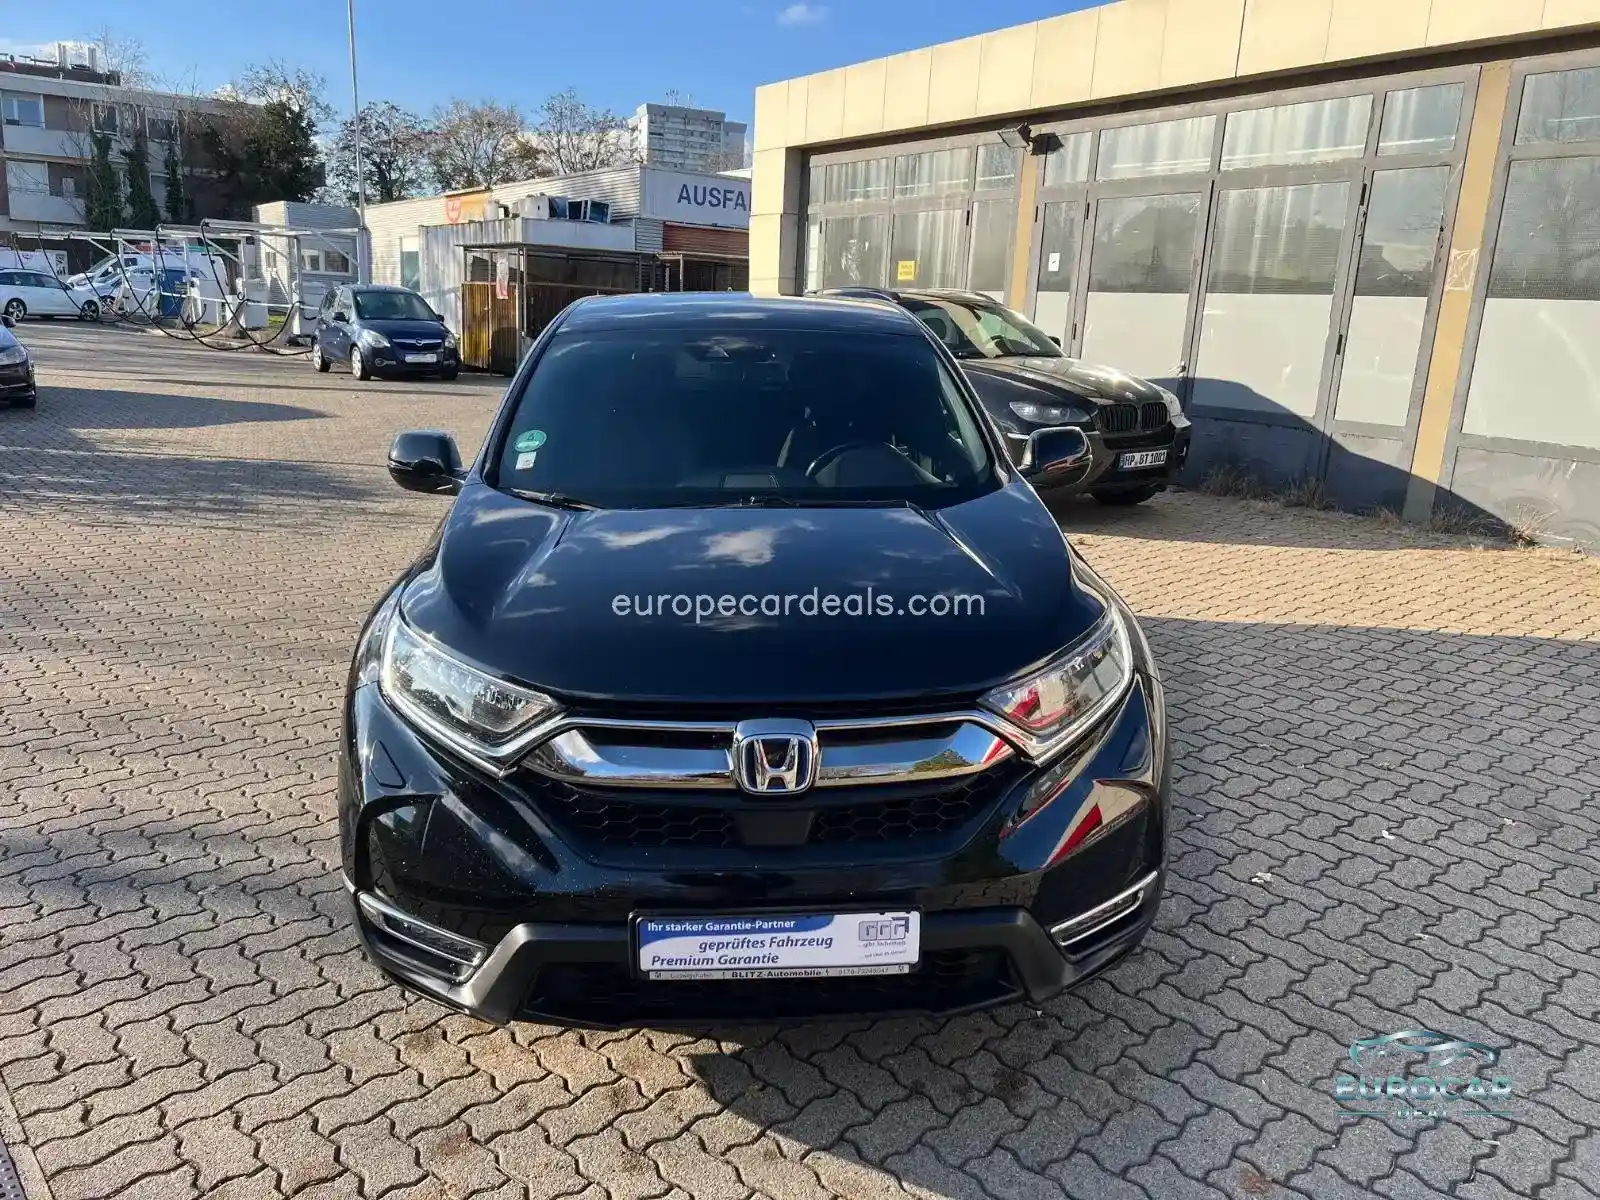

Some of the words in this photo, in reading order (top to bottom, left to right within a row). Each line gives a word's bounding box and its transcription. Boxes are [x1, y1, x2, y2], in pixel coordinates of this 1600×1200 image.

[677, 183, 752, 212] AUSFA
[647, 922, 662, 931] Ihr
[665, 922, 702, 932] starker
[705, 920, 796, 931] Garantie-Partner
[699, 937, 766, 953] geprüftes
[769, 935, 833, 949] Fahrzeug
[651, 955, 714, 966] Premium
[718, 952, 779, 965] Garantie
[731, 968, 821, 978] BLITZ-Automobile
